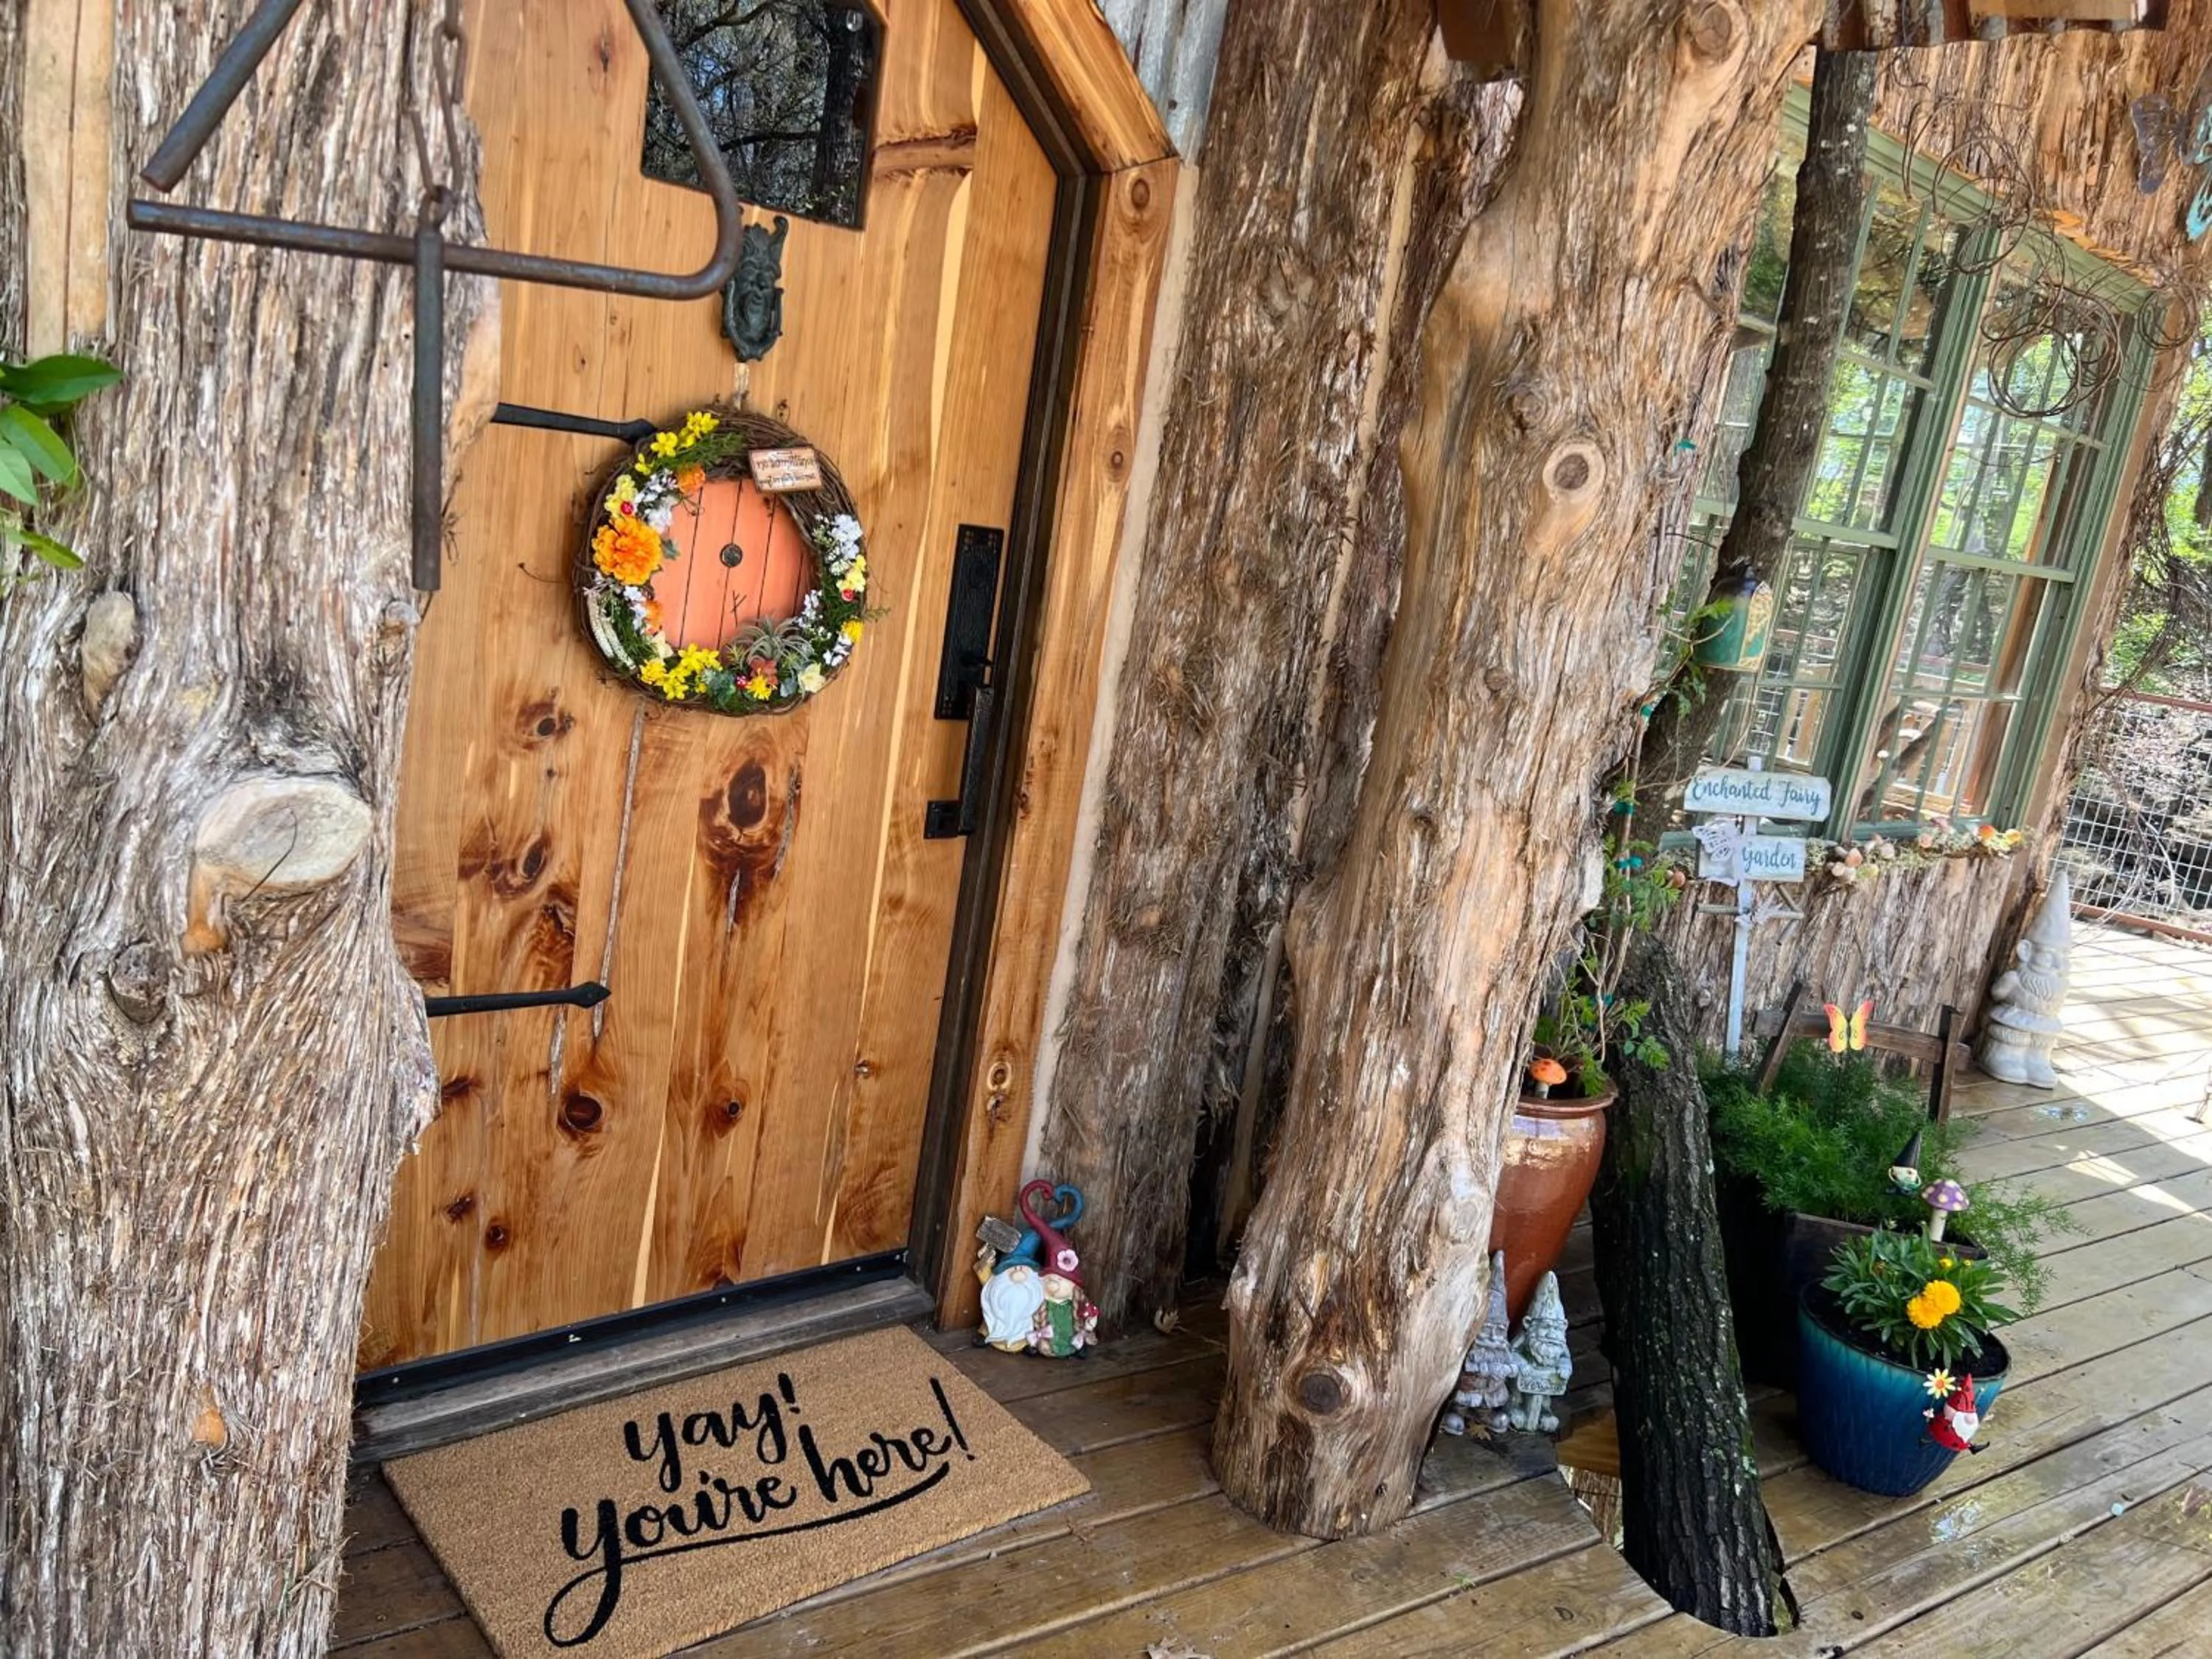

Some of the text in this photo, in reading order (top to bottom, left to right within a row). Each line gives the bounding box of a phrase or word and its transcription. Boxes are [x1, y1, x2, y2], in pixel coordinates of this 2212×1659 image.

[1692, 775, 1822, 815] Enchanted Fairy
[799, 1377, 975, 1503] here!
